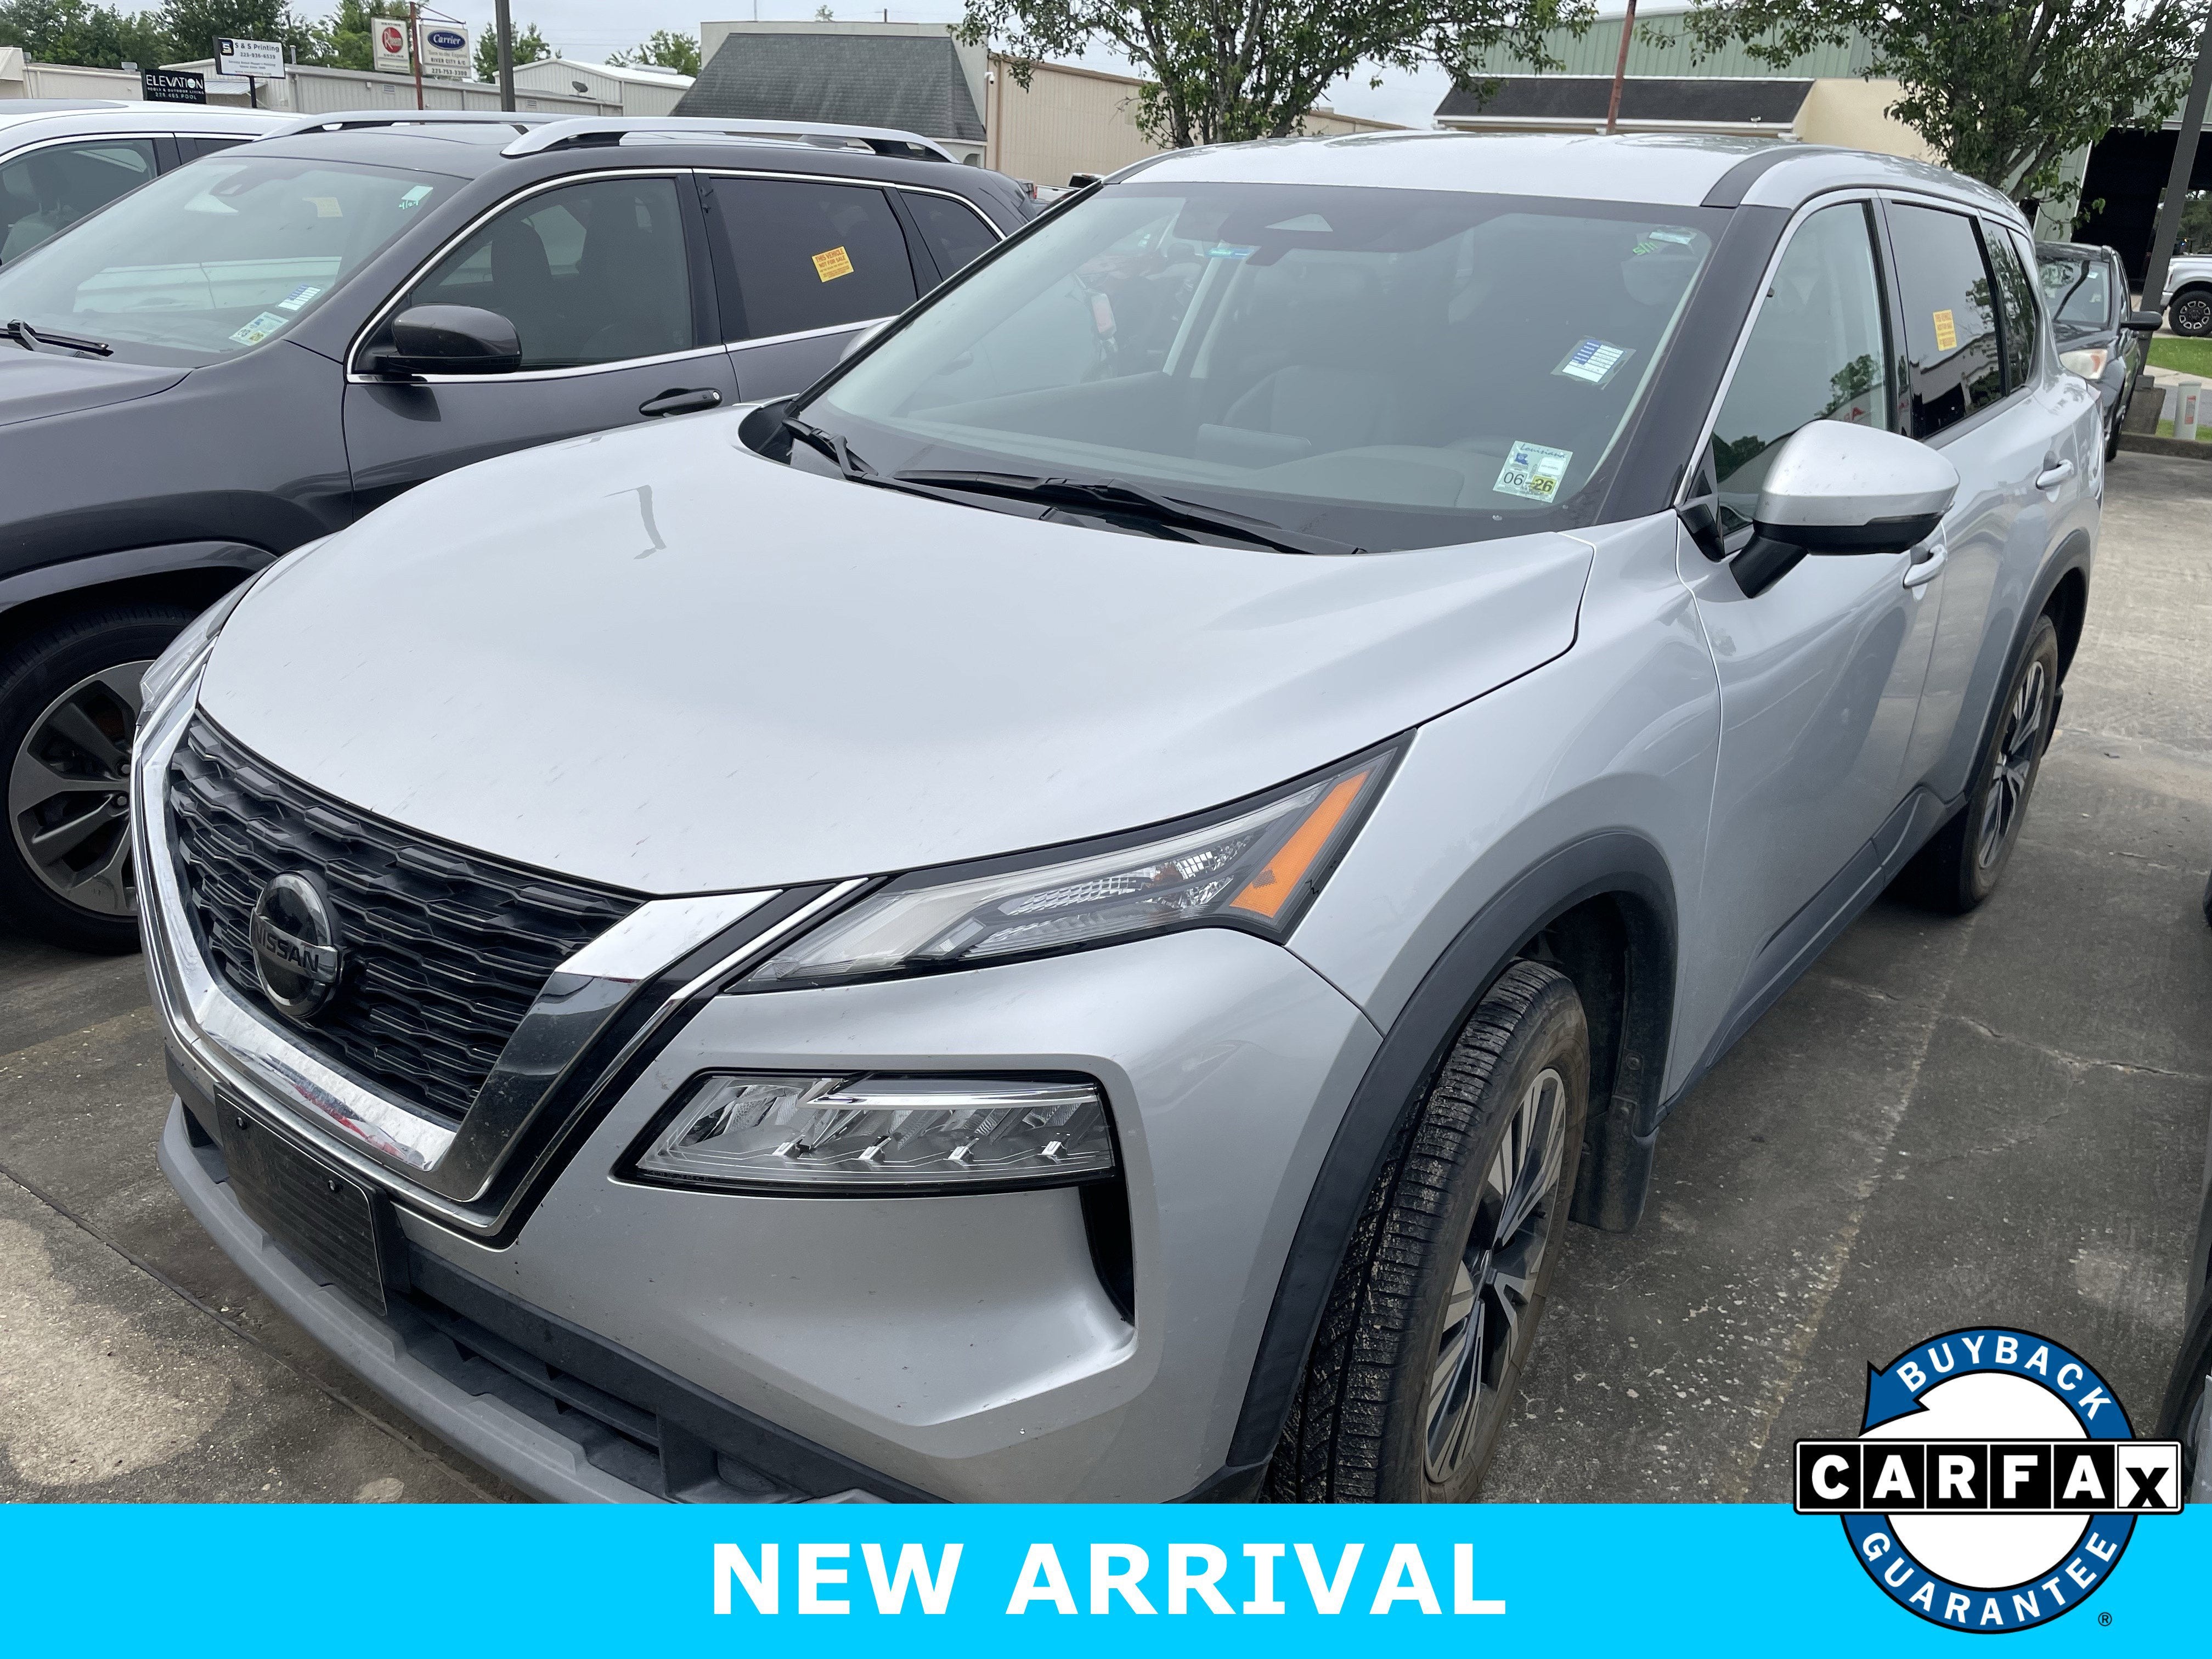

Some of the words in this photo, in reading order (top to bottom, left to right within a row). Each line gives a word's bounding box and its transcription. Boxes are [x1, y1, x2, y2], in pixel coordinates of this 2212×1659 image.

[433, 33, 461, 44] Carrier
[253, 44, 280, 53] Printing
[146, 74, 204, 89] ELEVATION
[1520, 443, 1566, 458] Louisiana
[1504, 472, 1525, 486] 06
[1534, 478, 1554, 492] 26
[254, 921, 319, 973] NISSAN
